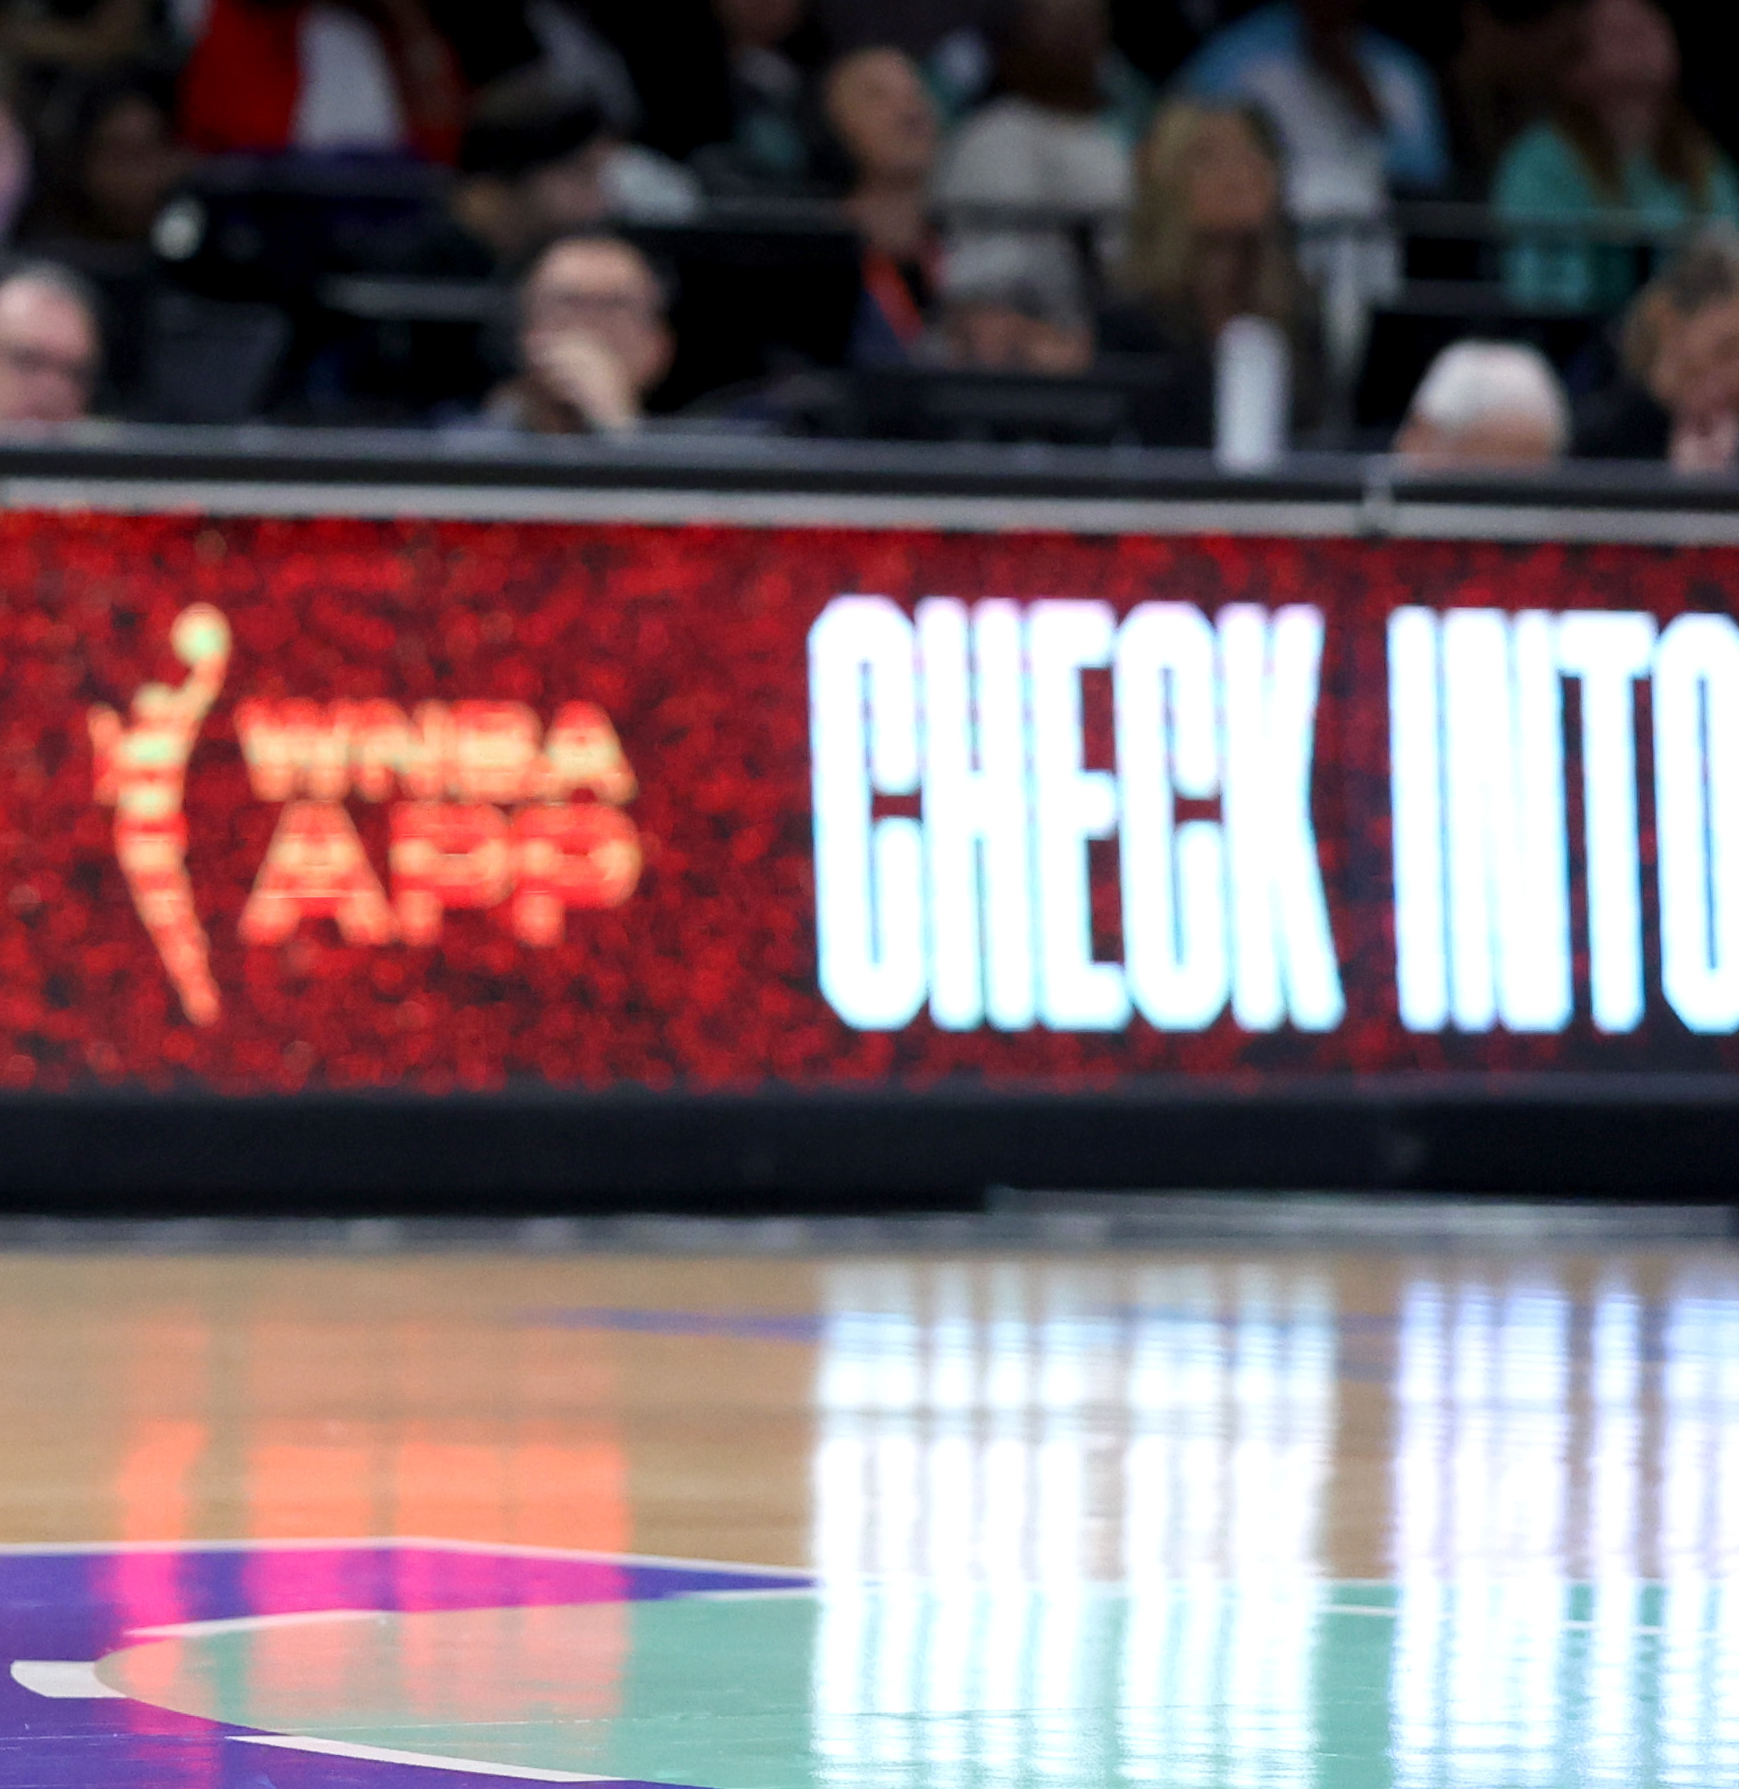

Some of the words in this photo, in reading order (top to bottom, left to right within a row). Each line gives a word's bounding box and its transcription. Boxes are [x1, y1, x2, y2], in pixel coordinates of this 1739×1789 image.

[233, 696, 638, 805] WNBA
[807, 592, 1346, 1033] CHECK
[1385, 604, 1739, 1035] INTO
[236, 800, 642, 947] APP
